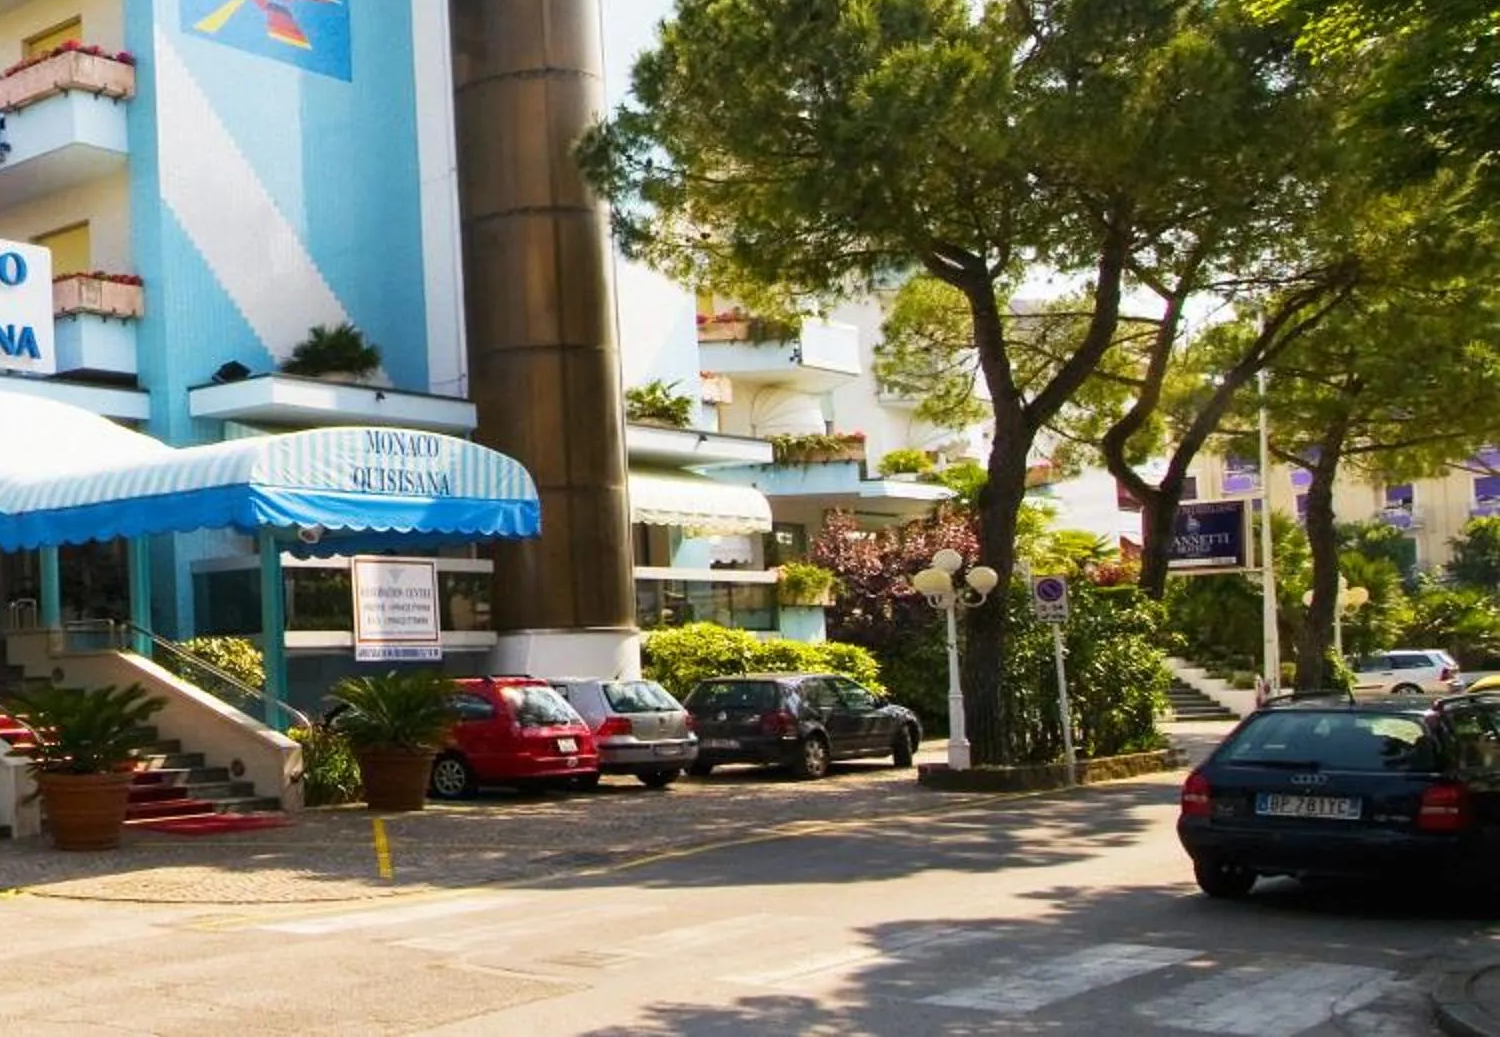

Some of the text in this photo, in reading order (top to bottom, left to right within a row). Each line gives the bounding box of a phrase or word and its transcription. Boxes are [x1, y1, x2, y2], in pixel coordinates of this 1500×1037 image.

[365, 429, 440, 458] MONACO
[353, 466, 450, 496] QUISISANA
[1170, 532, 1229, 546] ANNETTI
